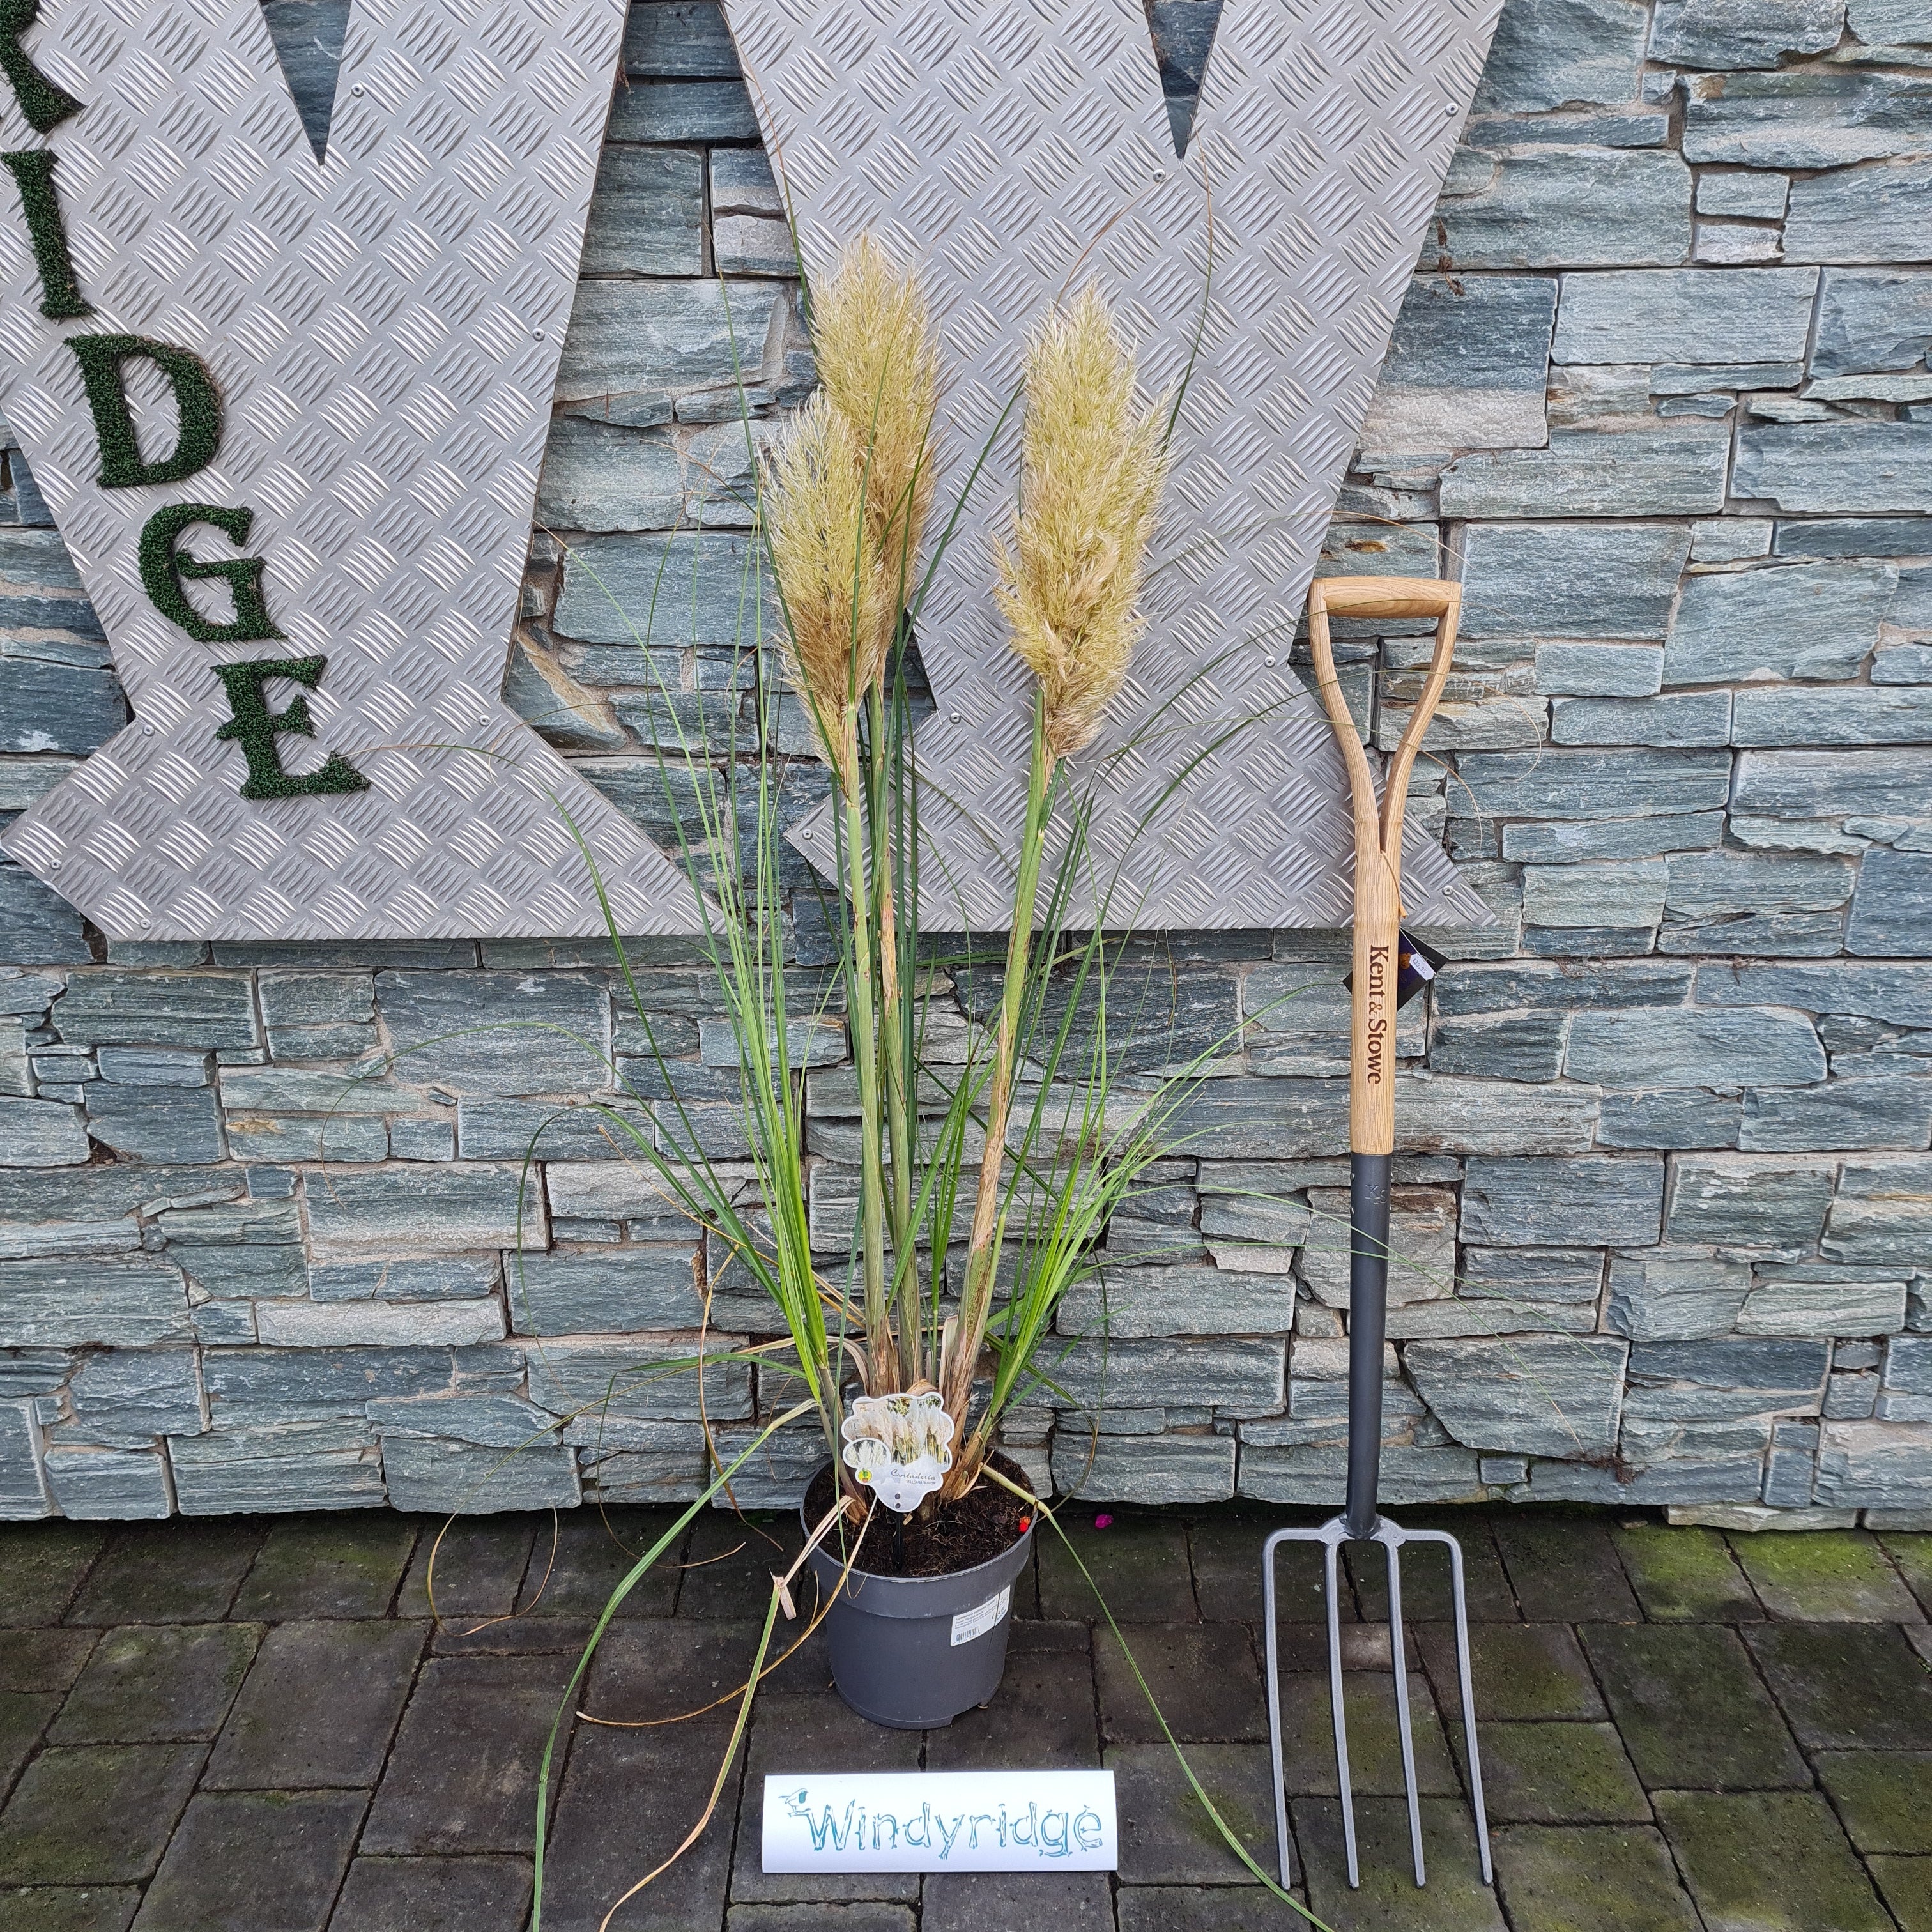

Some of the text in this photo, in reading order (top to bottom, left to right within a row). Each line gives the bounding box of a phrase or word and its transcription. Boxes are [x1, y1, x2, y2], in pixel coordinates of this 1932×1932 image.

[1367, 944, 1389, 1085] Kent & Stowe
[891, 1469, 936, 1480] Cortaderia
[788, 1798, 1103, 1860] Windyridge
